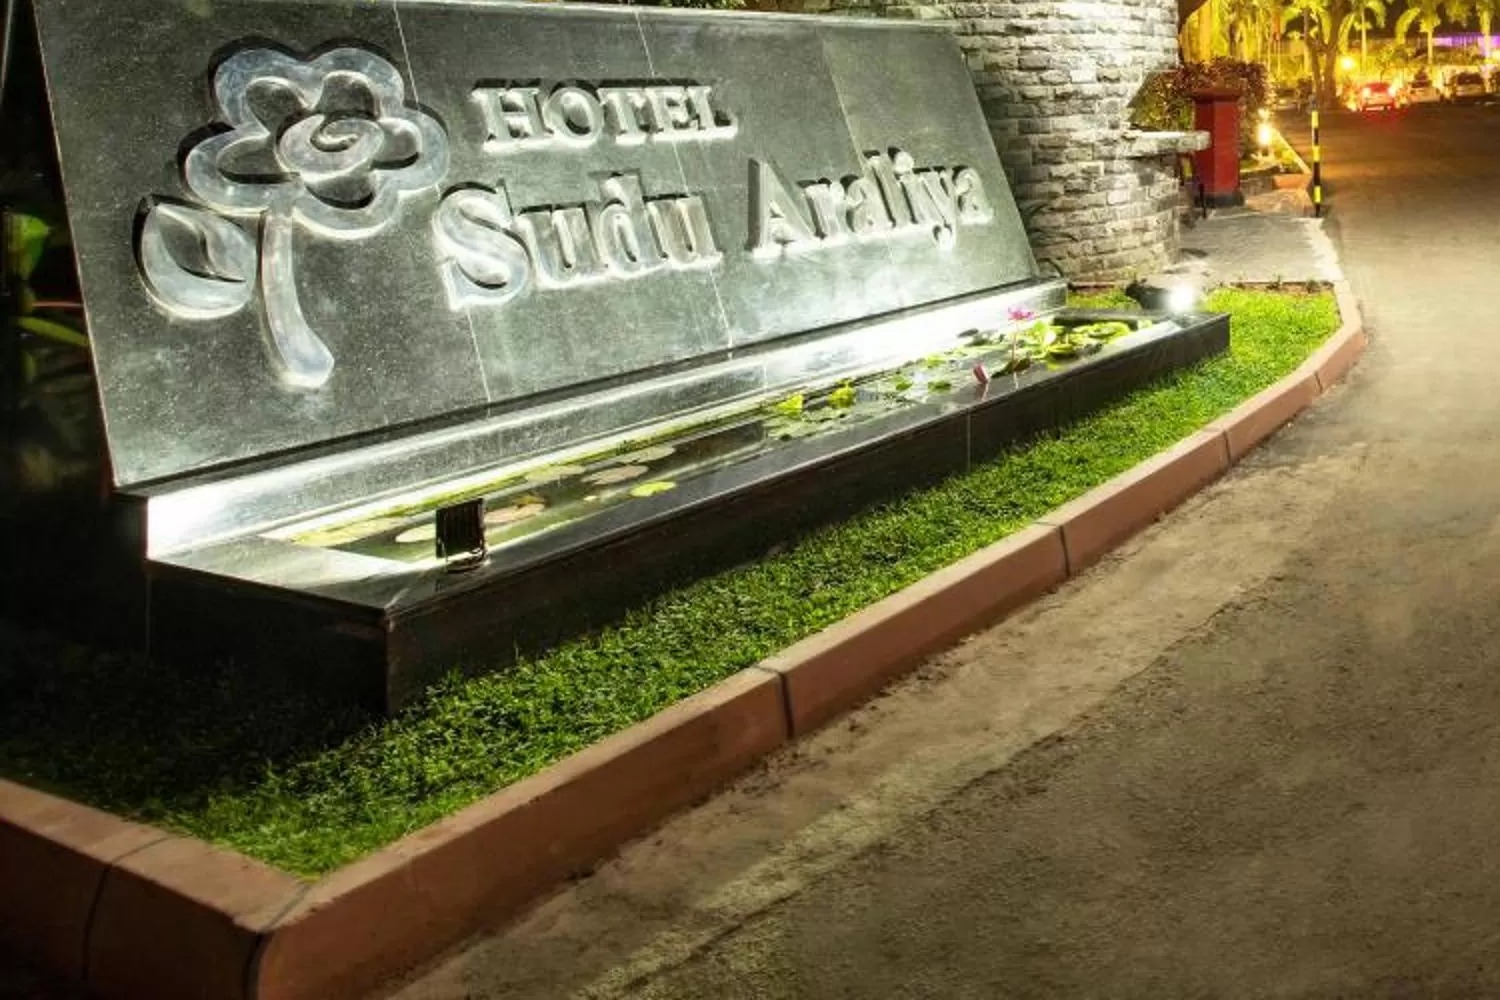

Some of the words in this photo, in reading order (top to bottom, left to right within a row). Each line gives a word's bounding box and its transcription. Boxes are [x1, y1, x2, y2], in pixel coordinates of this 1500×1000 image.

[471, 80, 739, 152] HOTEL
[432, 172, 722, 309] Sudu
[745, 148, 993, 258] Araliya
